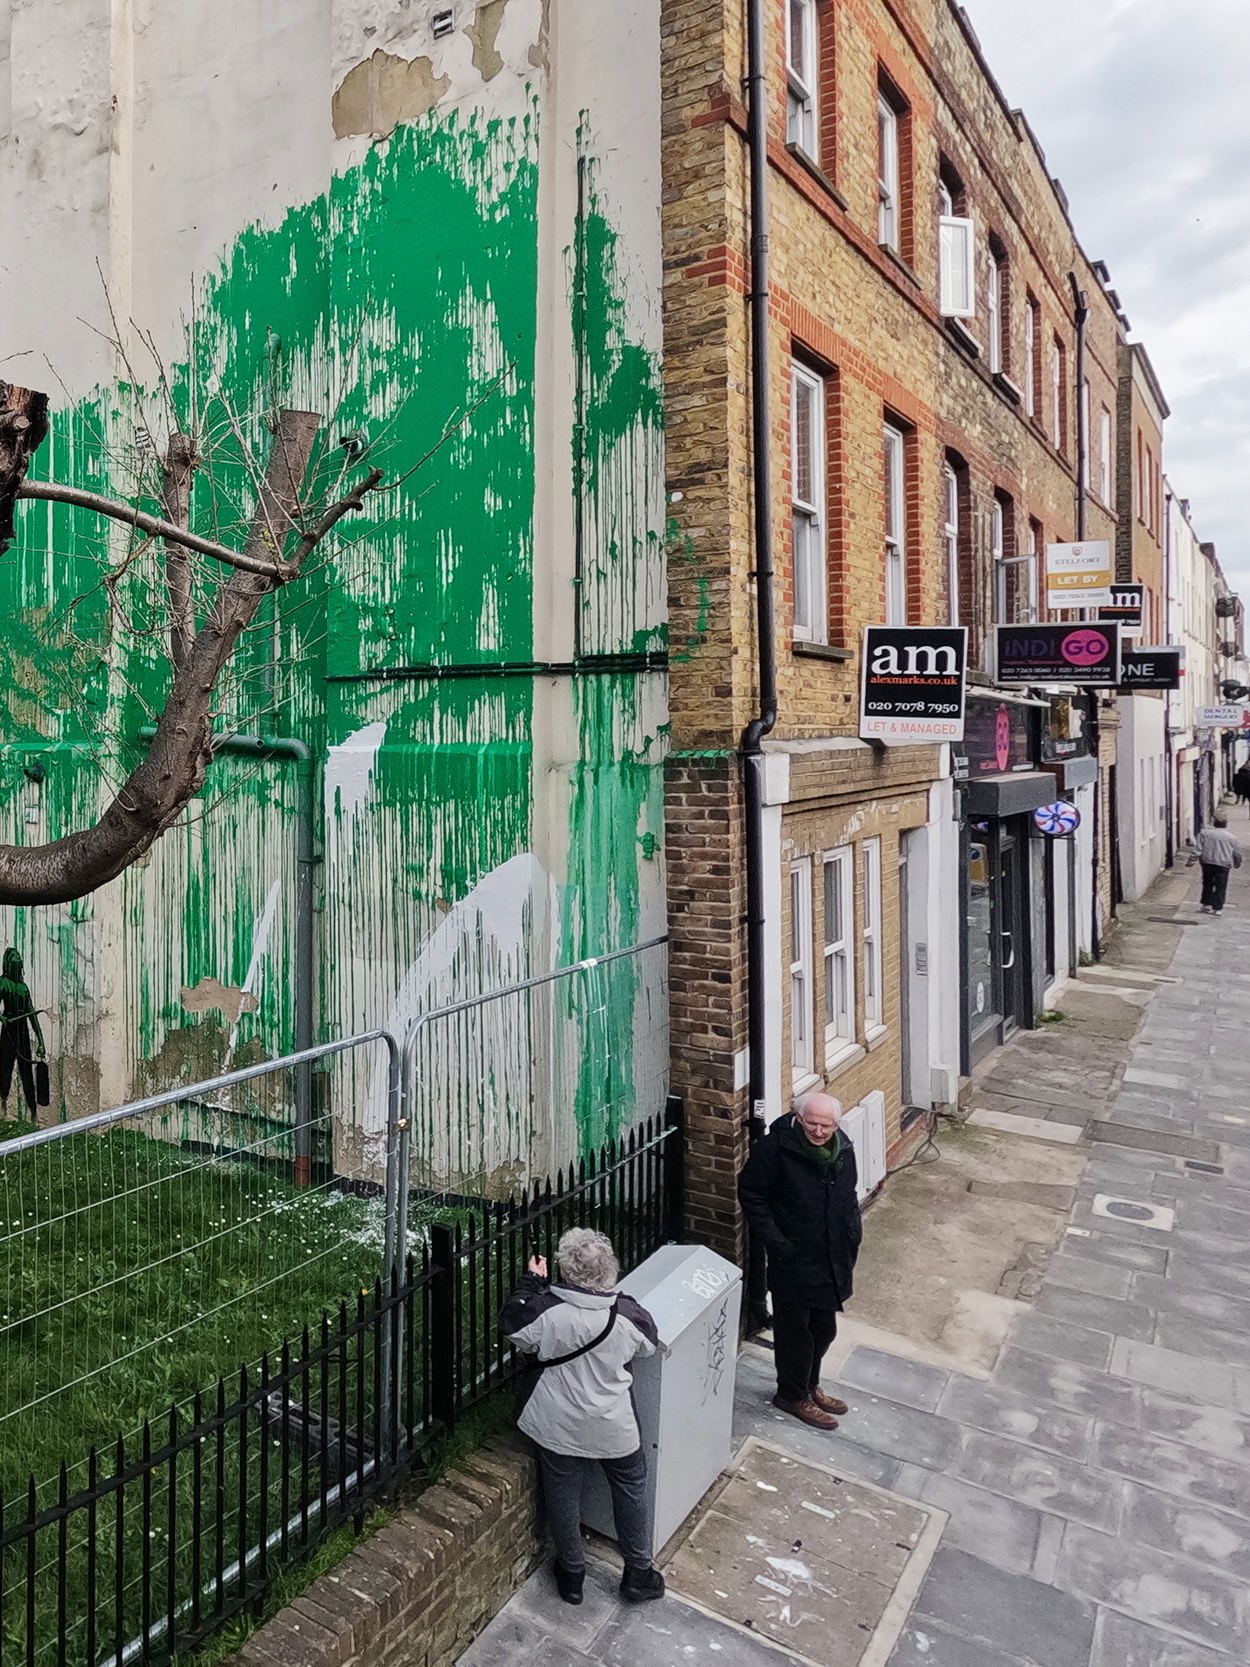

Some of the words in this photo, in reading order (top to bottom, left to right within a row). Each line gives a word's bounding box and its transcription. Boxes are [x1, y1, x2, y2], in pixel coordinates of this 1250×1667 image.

[1057, 575, 1079, 585] LET
[1082, 574, 1099, 584] BY
[1110, 591, 1142, 607] m
[871, 645, 960, 675] am
[870, 675, 958, 685] alexmarks.co.uk
[868, 701, 892, 710] 020
[894, 701, 925, 712] 7078
[927, 703, 959, 714] 7950
[867, 721, 887, 732] LET
[889, 722, 897, 733] &
[900, 722, 957, 735] MANAGED
